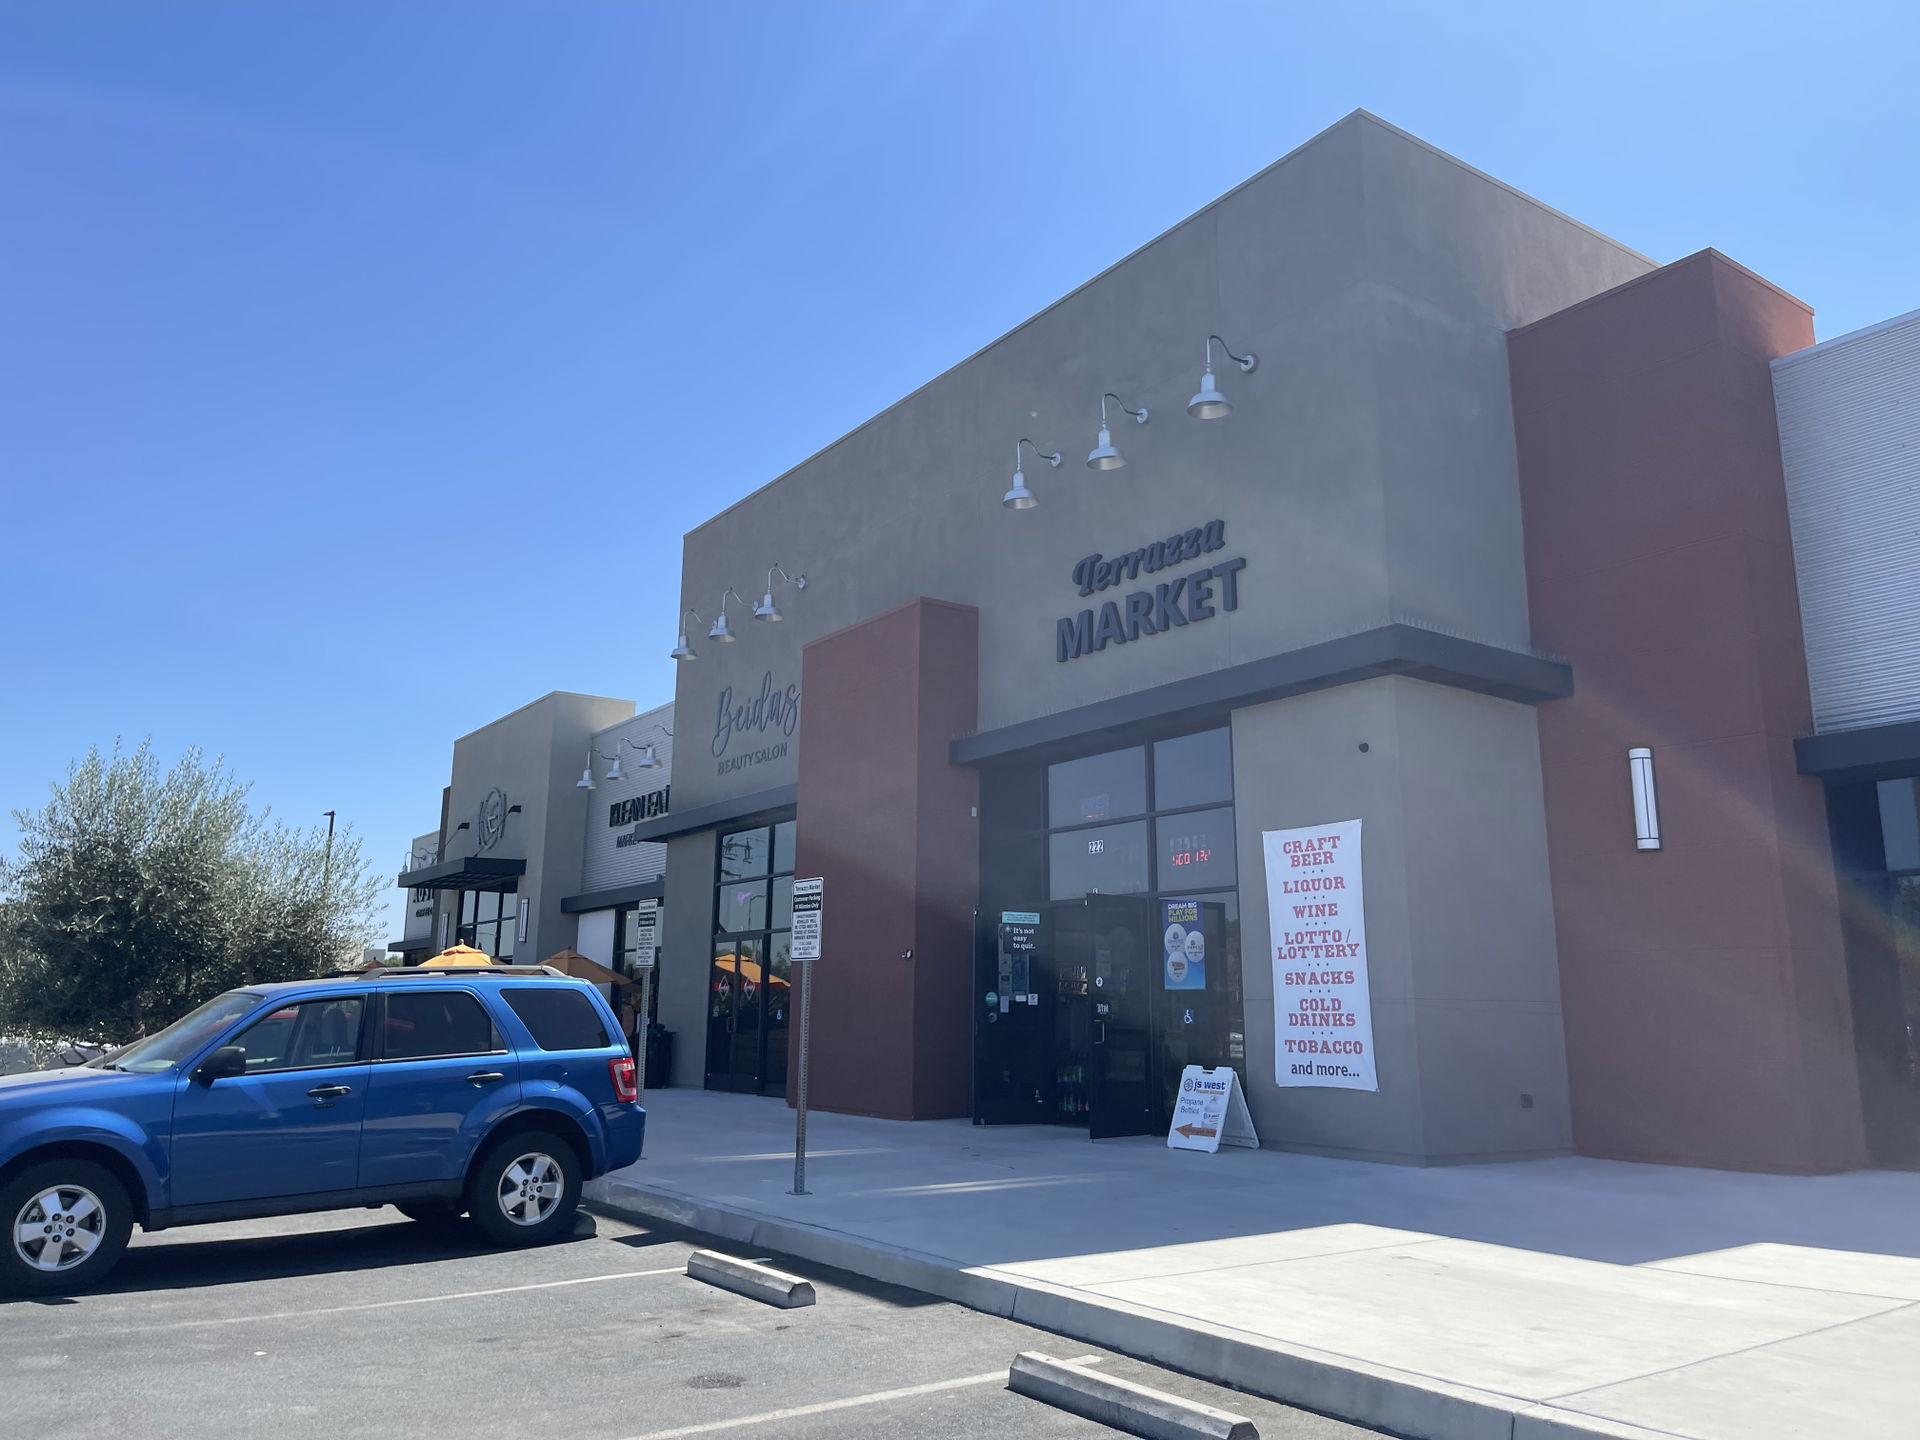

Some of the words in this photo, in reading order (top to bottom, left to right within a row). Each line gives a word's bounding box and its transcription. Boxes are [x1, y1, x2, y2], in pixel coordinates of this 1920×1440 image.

[1072, 519, 1226, 597] Terrazza
[1056, 557, 1247, 663] MARKET
[712, 671, 801, 758] Beidas
[1089, 840, 1104, 854] 222
[1283, 836, 1341, 854] CRAFT
[1291, 851, 1335, 868] BEER
[1283, 876, 1346, 894] LIQUOR
[1168, 914, 1198, 923] MILLIONS
[1293, 903, 1338, 919] WINE
[1277, 943, 1360, 960] LOTTERY
[1285, 971, 1355, 986] SNACKS
[1299, 998, 1342, 1012] COLD
[1288, 1013, 1356, 1027] DRINKS
[1284, 1039, 1363, 1055] TOBACCO
[1291, 1060, 1313, 1075] and
[1316, 1063, 1360, 1078] more...
[1204, 1080, 1226, 1091] west
